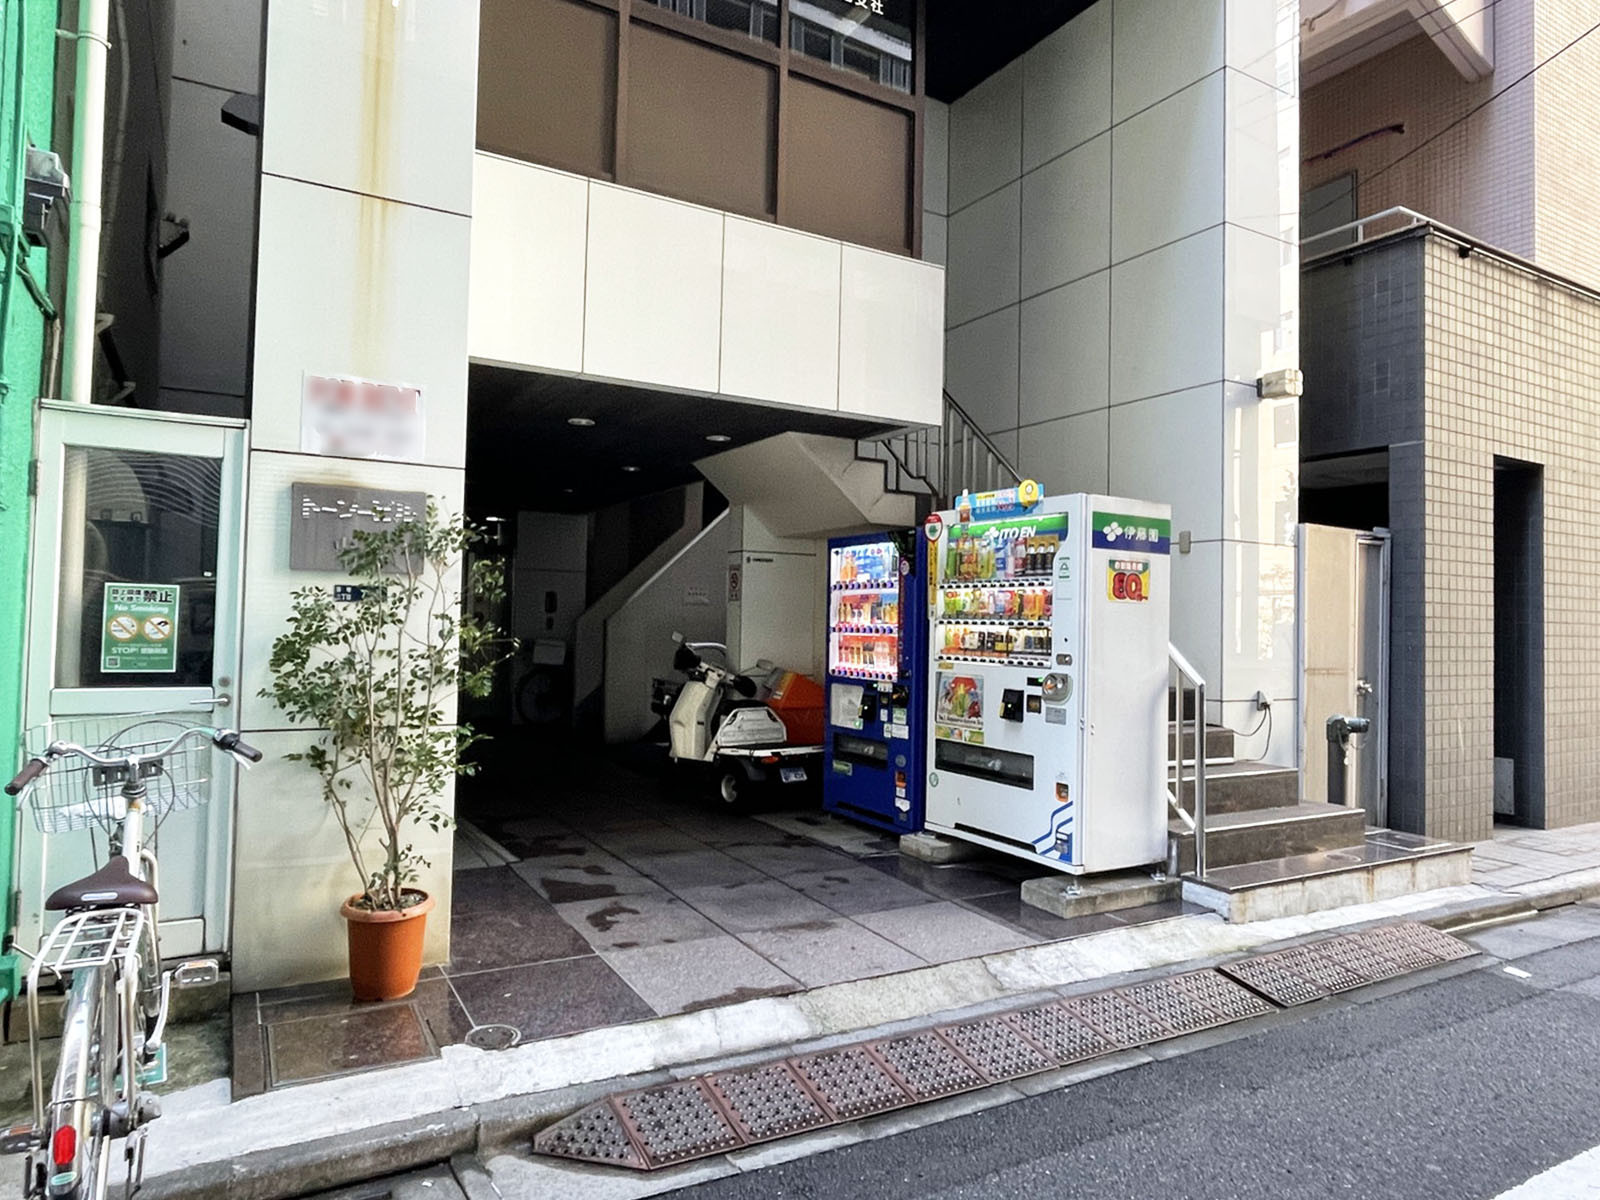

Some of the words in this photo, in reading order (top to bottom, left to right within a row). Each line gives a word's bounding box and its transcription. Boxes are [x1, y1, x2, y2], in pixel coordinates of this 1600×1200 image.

[999, 527, 1019, 540] ITO
[1019, 525, 1037, 538] EN
[143, 590, 173, 603] 禁止
